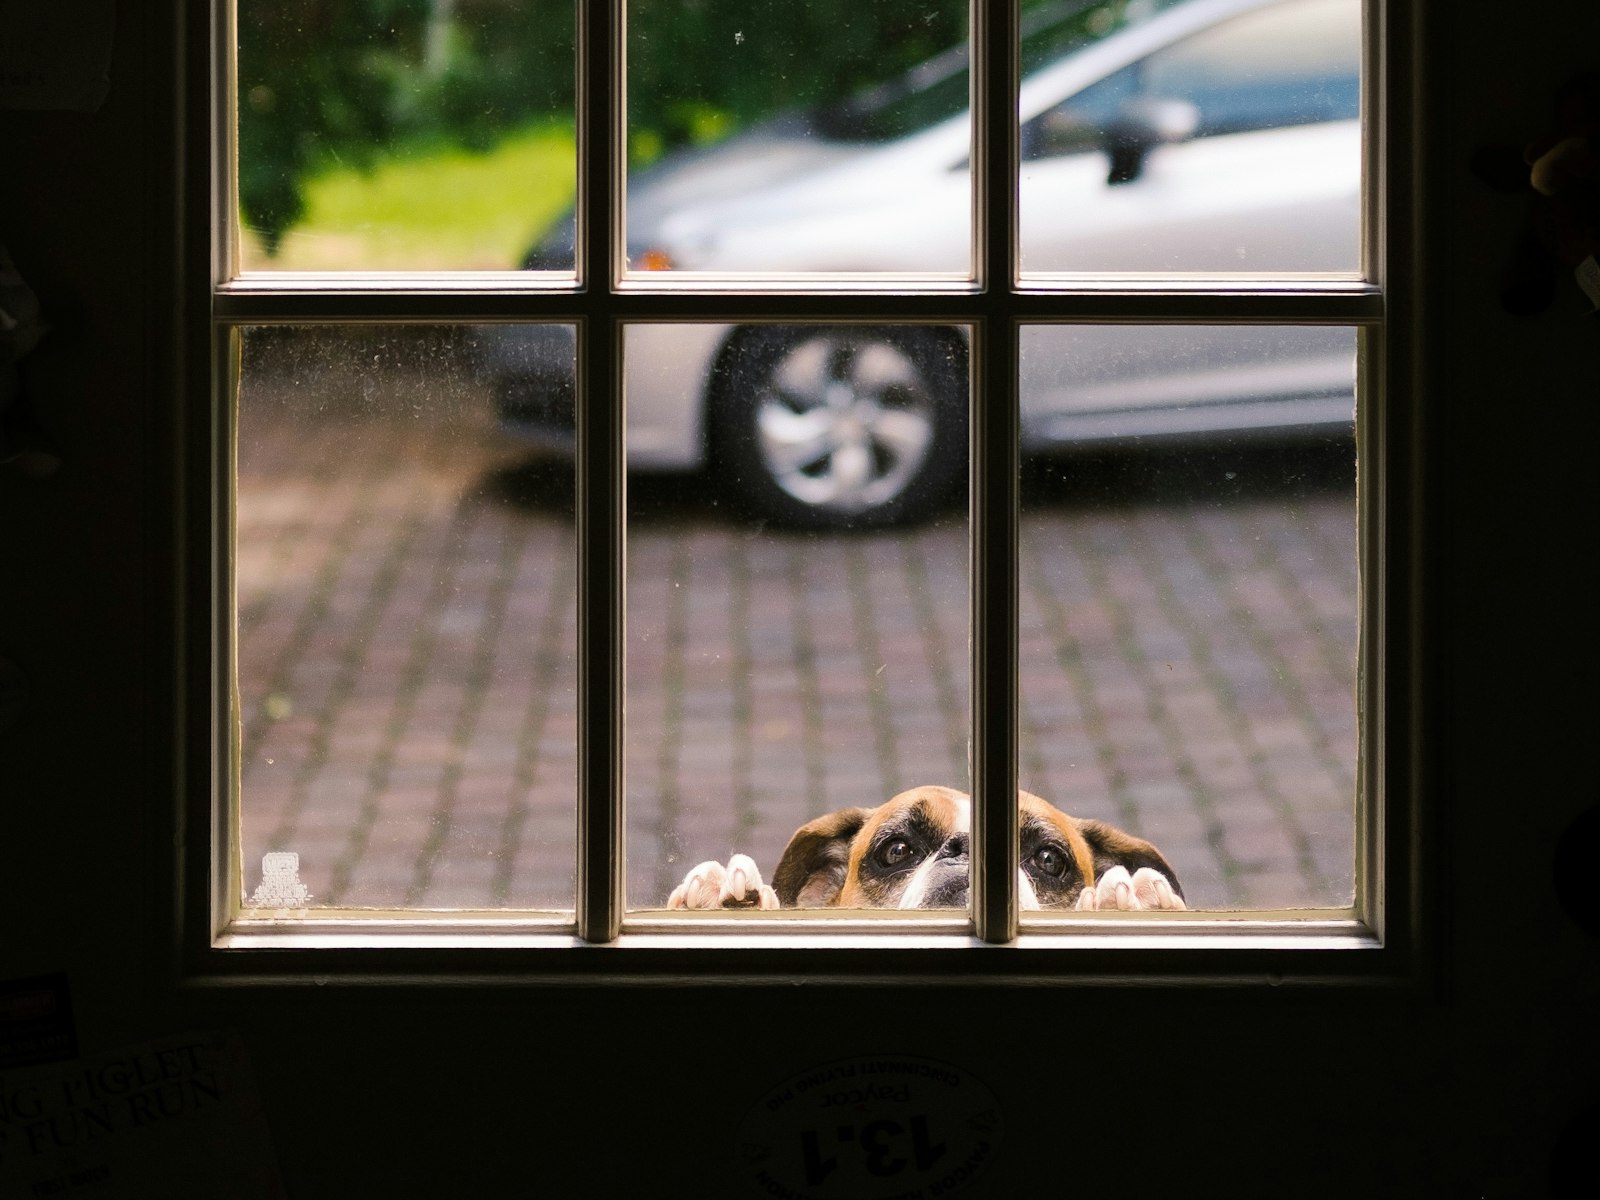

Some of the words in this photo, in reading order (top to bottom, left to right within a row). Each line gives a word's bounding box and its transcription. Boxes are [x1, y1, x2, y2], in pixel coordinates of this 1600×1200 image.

[61, 1043, 204, 1108] PIGLET
[797, 1063, 857, 1094] FLYING
[819, 1082, 911, 1109] Paycor
[860, 1060, 961, 1088] CINCINNATI
[23, 1103, 114, 1155] FUN
[125, 1071, 221, 1128] RUN
[765, 1089, 795, 1112] PIG
[799, 1114, 948, 1187] 13.1
[928, 1139, 992, 1198] PAYCOR
